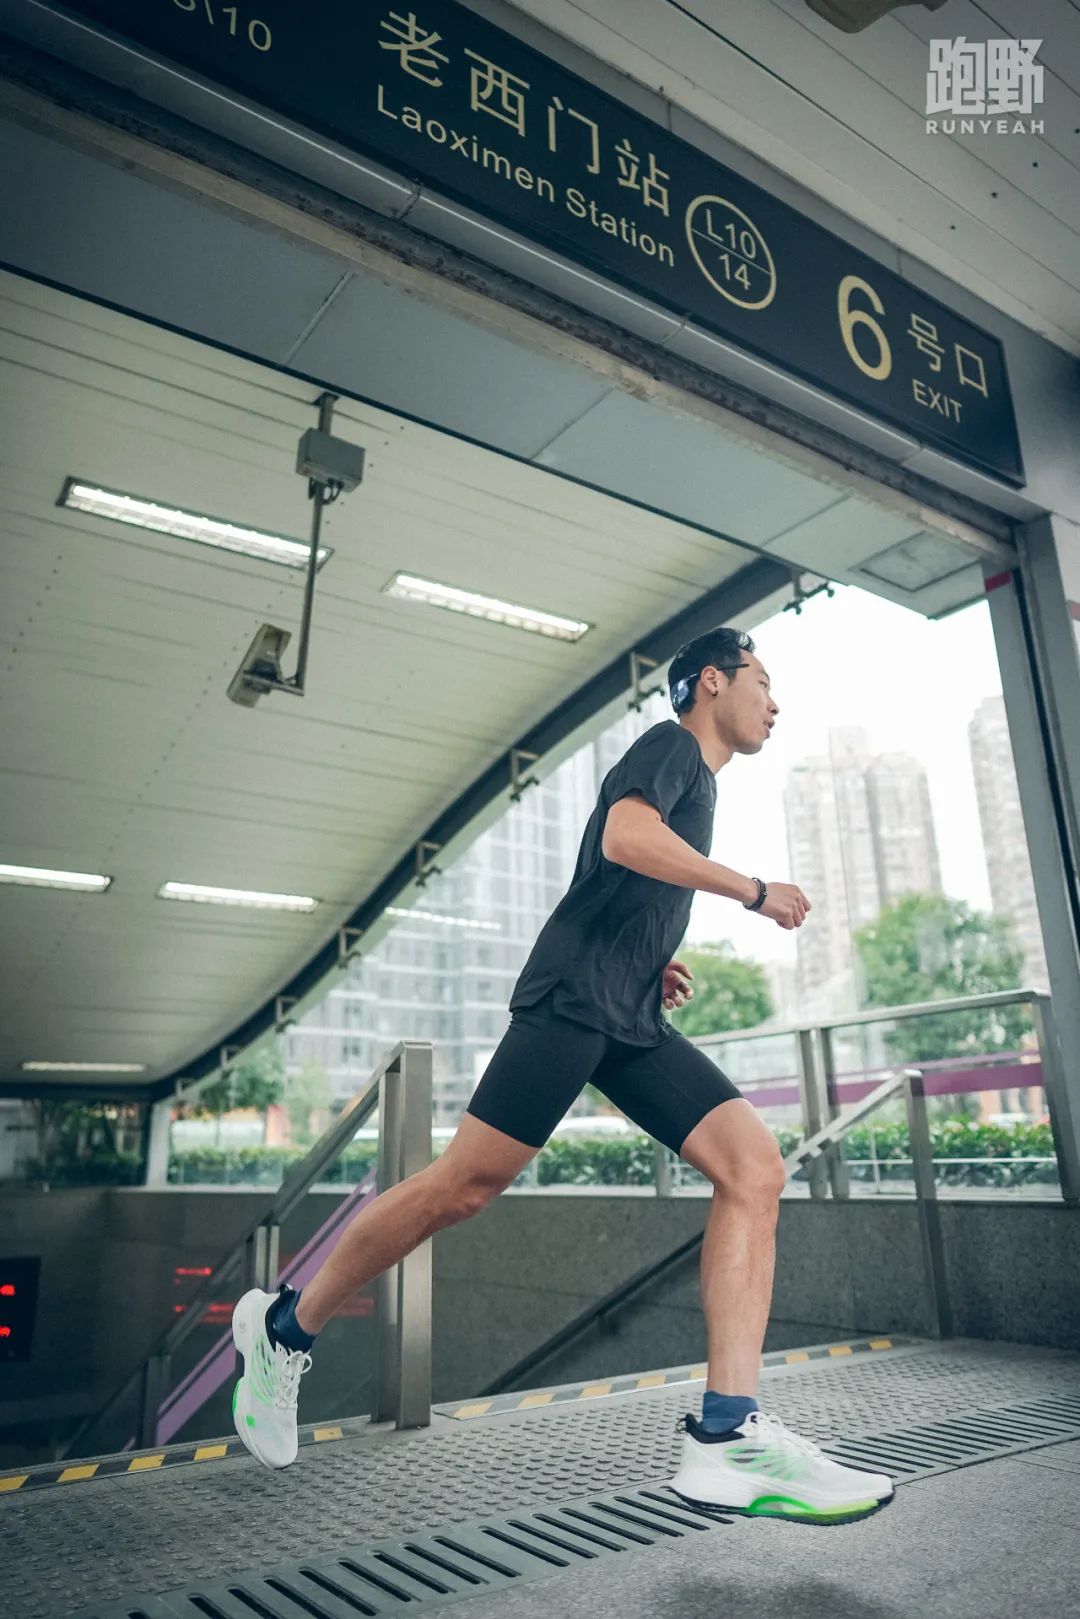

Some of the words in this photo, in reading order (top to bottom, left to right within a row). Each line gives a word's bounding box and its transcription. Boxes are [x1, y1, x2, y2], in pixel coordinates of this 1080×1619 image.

[378, 11, 670, 217] 老西门站
[377, 84, 555, 203] Laoximen
[566, 187, 675, 267] Station
[706, 209, 757, 259] L10
[719, 253, 751, 291] 14
[912, 378, 962, 423] EXIT
